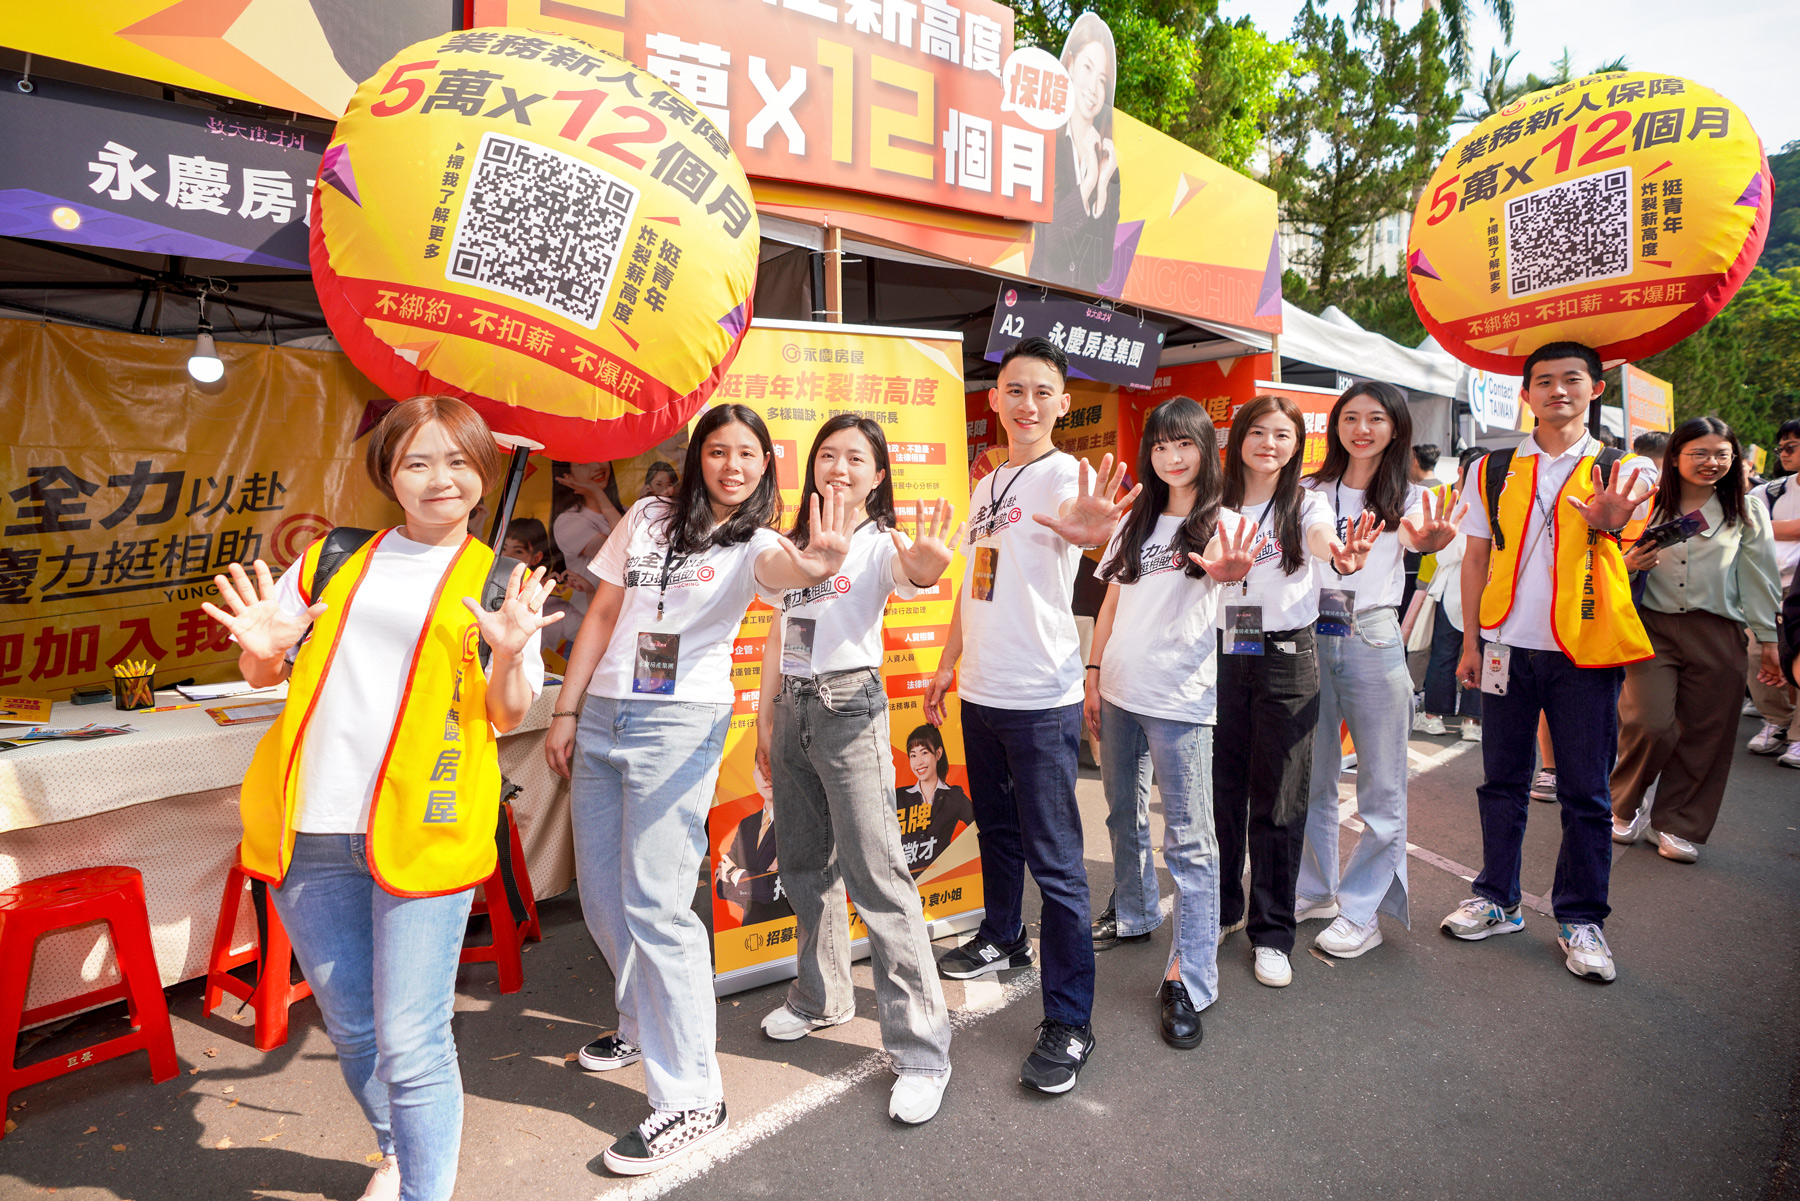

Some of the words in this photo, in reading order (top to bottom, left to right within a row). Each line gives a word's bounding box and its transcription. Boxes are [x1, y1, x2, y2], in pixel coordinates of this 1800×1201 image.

[437, 31, 732, 160] 業務新人保障
[1009, 63, 1070, 116] 保障
[1456, 78, 1686, 169] 業務新人保障
[88, 140, 316, 228] 永慶房
[423, 154, 465, 259] 掃我了解更多
[1662, 178, 1683, 234] 挺青年
[1640, 182, 1658, 257] 炸裂薪高度
[612, 224, 658, 325] 炸裂薪高度
[643, 238, 682, 313] 挺青年
[1486, 224, 1501, 294] 掃我了解更多
[999, 313, 1025, 339] A2
[1048, 321, 1146, 369] 永慶房產集團
[803, 347, 865, 365] 永慶房屋
[716, 371, 939, 407] 挺青年炸裂薪高度
[1488, 377, 1514, 399] Contact
[1489, 398, 1514, 420] TAIWAN
[4, 460, 287, 537] 全力以赴
[907, 679, 934, 690] 法律相
[730, 719, 758, 729] 社群行
